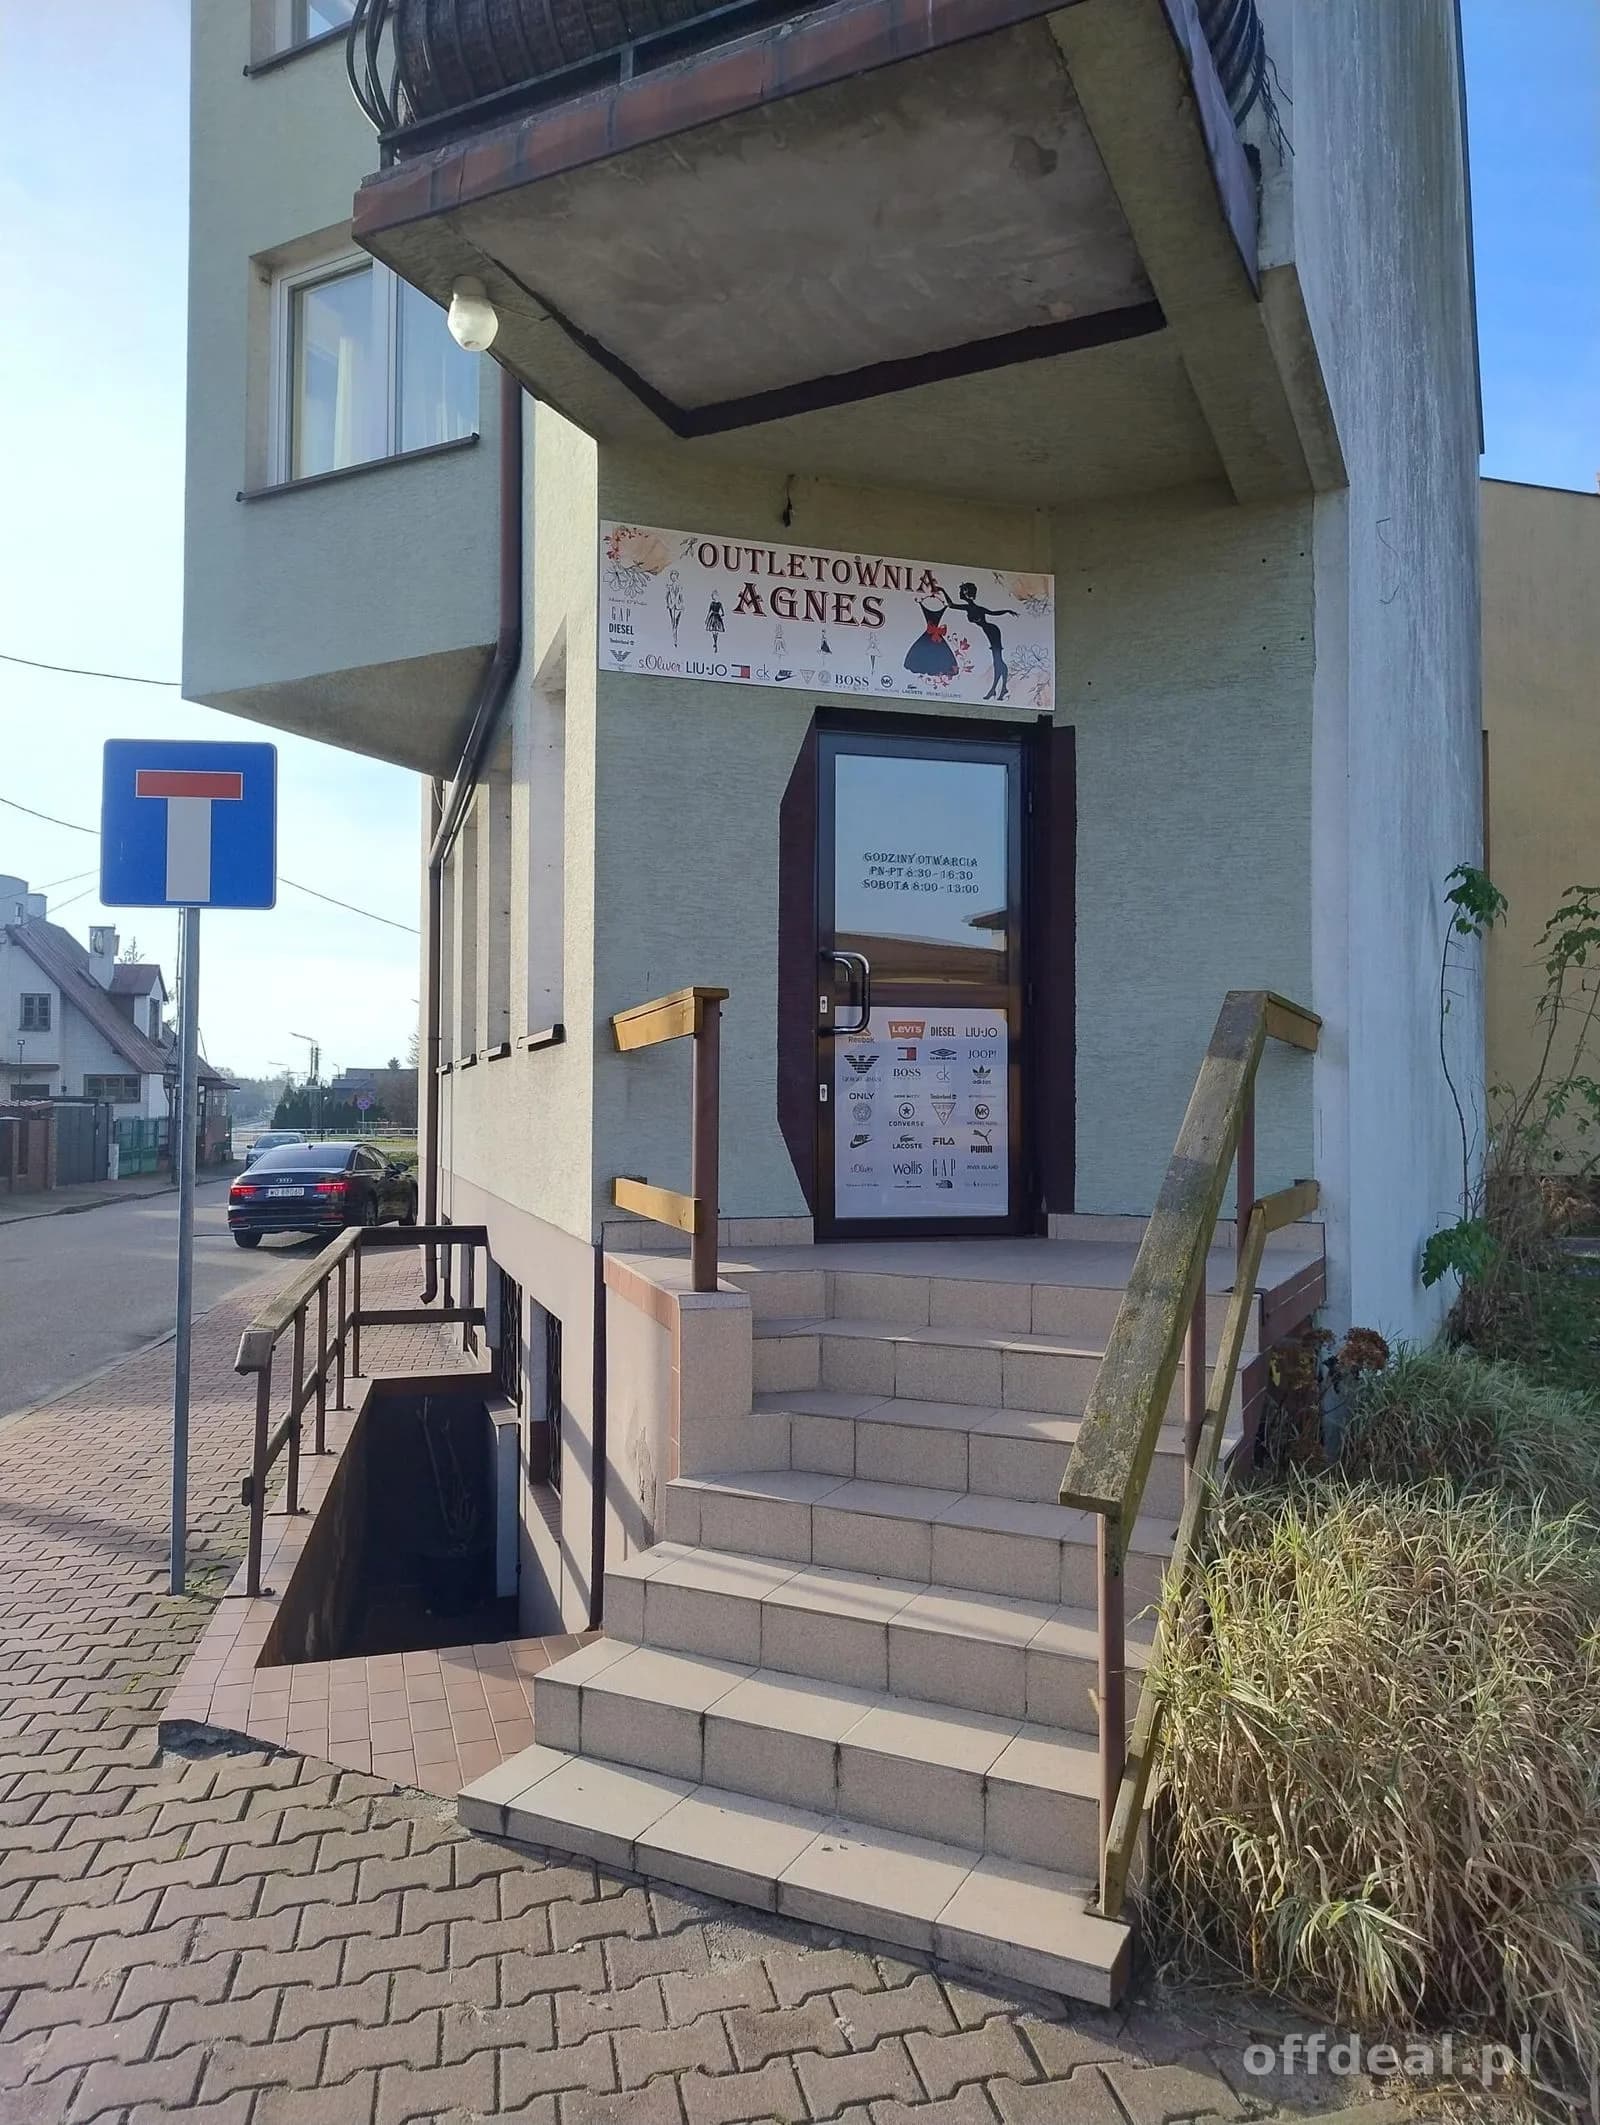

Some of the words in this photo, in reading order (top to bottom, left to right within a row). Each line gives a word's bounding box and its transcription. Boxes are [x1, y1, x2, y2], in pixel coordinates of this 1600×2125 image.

[698, 542, 939, 594] OUTLETOWNIA
[733, 582, 886, 629] AGNES
[608, 622, 635, 636] DIESEL
[756, 663, 770, 679] ck
[835, 673, 870, 687] BOSS
[863, 852, 917, 864] GODZINY
[917, 854, 978, 867] OTWARCIA
[870, 866, 904, 877] PN-PT
[863, 878, 910, 890] SOBOTA
[930, 1026, 956, 1037] DIESEL
[968, 1049, 997, 1060] JOOP!
[893, 1068, 922, 1078] BOSS
[936, 1064, 951, 1081] ck
[849, 1092, 875, 1100] ONLY
[932, 1137, 955, 1146] FILA
[932, 1158, 956, 1177] GAP
